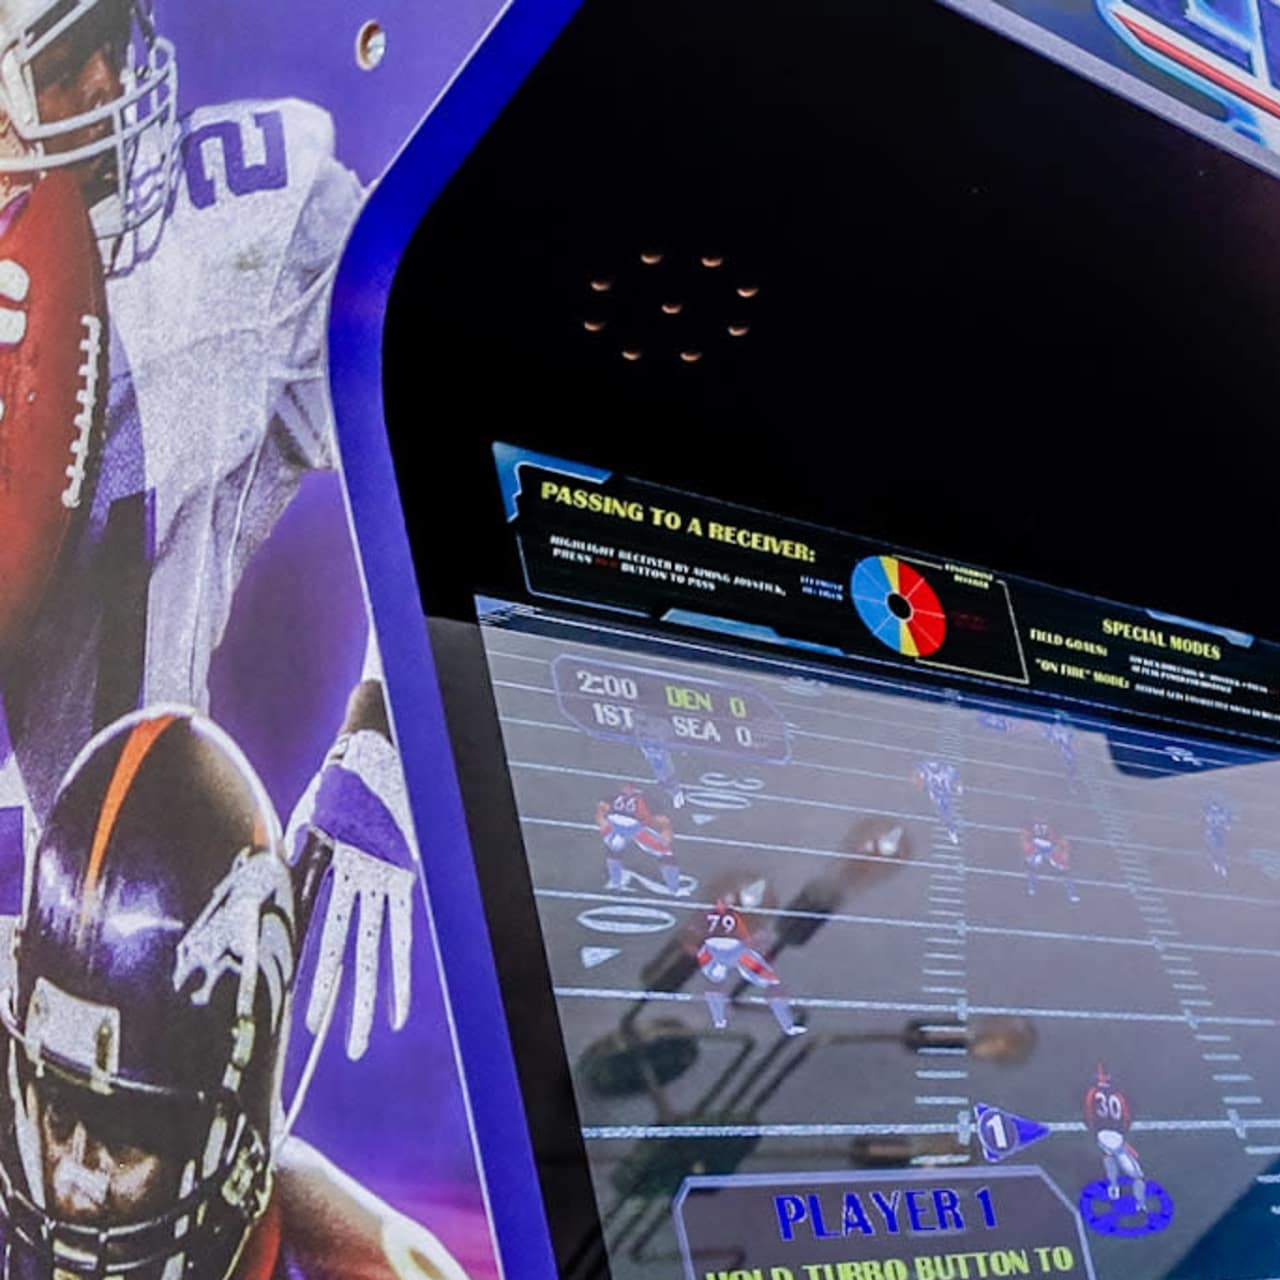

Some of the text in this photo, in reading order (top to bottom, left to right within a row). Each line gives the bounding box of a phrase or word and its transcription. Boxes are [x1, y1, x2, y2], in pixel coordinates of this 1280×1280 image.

[540, 481, 817, 563] PASSING TO A RECEIVER:
[550, 535, 615, 558] HIGHLIGHT
[552, 548, 593, 564] PRESS
[620, 562, 667, 581] BUTTON
[1029, 627, 1108, 656] FIELD GOALS:
[1102, 618, 1222, 661] SPECIAL MODES
[576, 670, 746, 719] 2:00 DEN 0
[593, 702, 753, 747] 1ST SEA 0
[706, 914, 736, 932] 79
[1095, 1091, 1122, 1120] 30
[986, 1115, 1007, 1149] 1
[772, 1186, 999, 1242] PLAYER 1
[1034, 1246, 1074, 1271] TO
